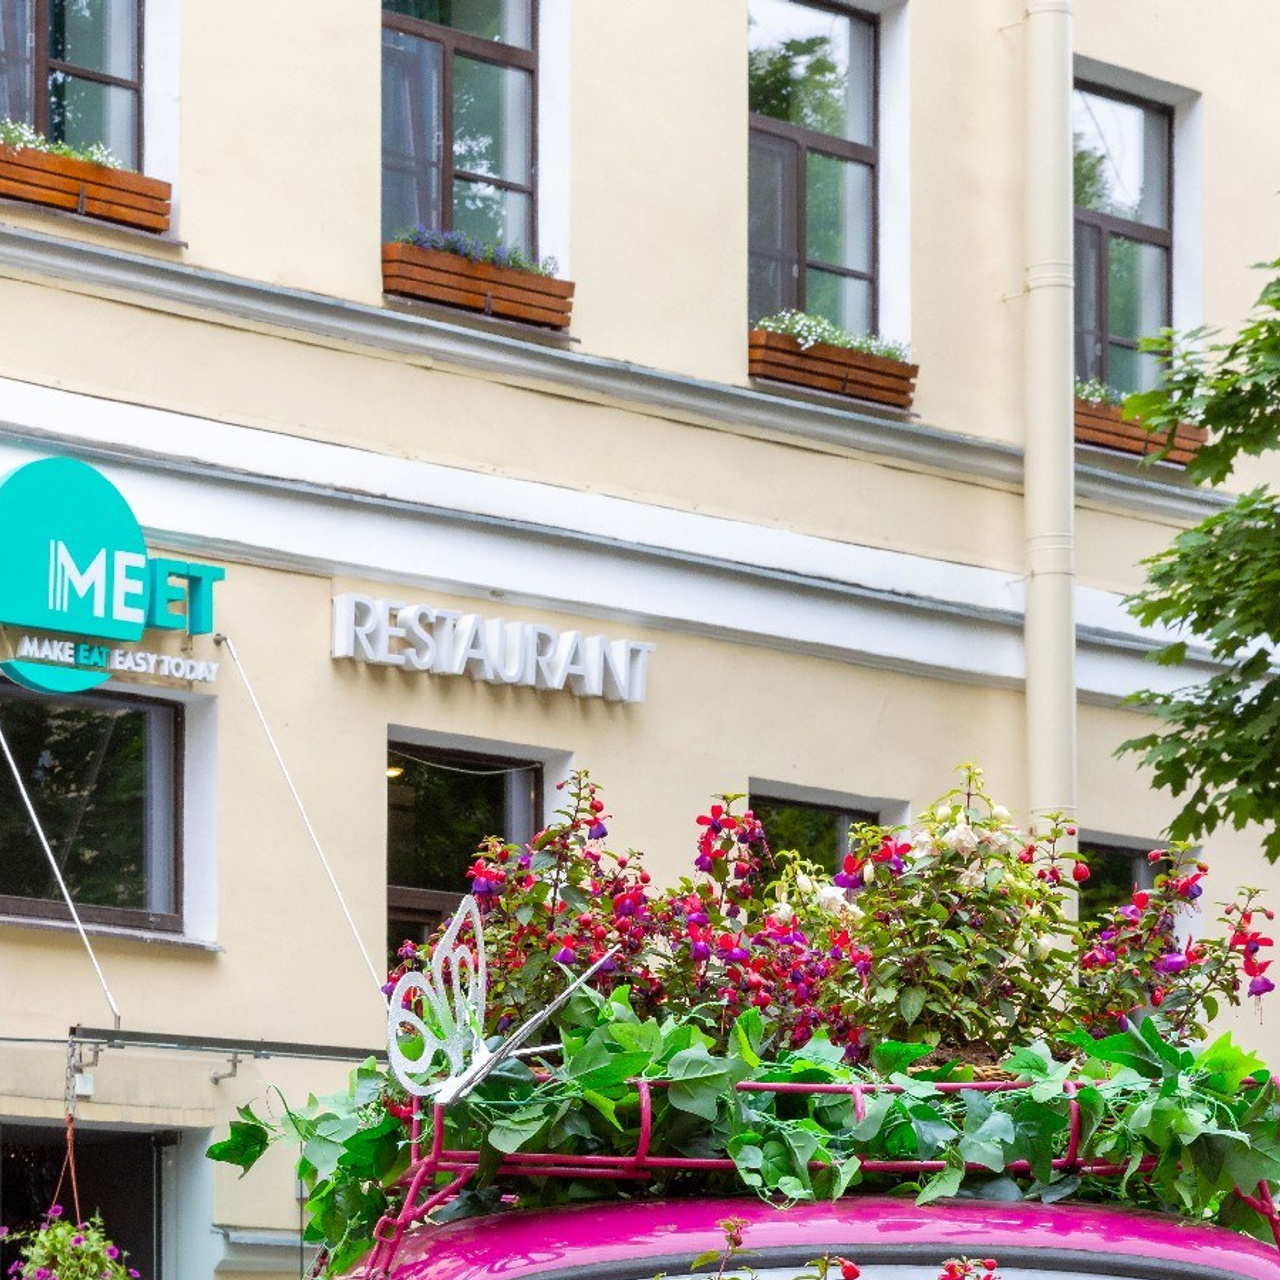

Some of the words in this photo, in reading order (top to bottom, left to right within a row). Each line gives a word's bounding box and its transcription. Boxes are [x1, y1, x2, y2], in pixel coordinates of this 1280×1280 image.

[48, 538, 226, 636] MEET
[17, 635, 75, 664] MAKE
[75, 643, 110, 669] EAT
[110, 648, 159, 674] EASY
[158, 654, 220, 683] TODAY
[331, 592, 657, 704] RESTAURANT
